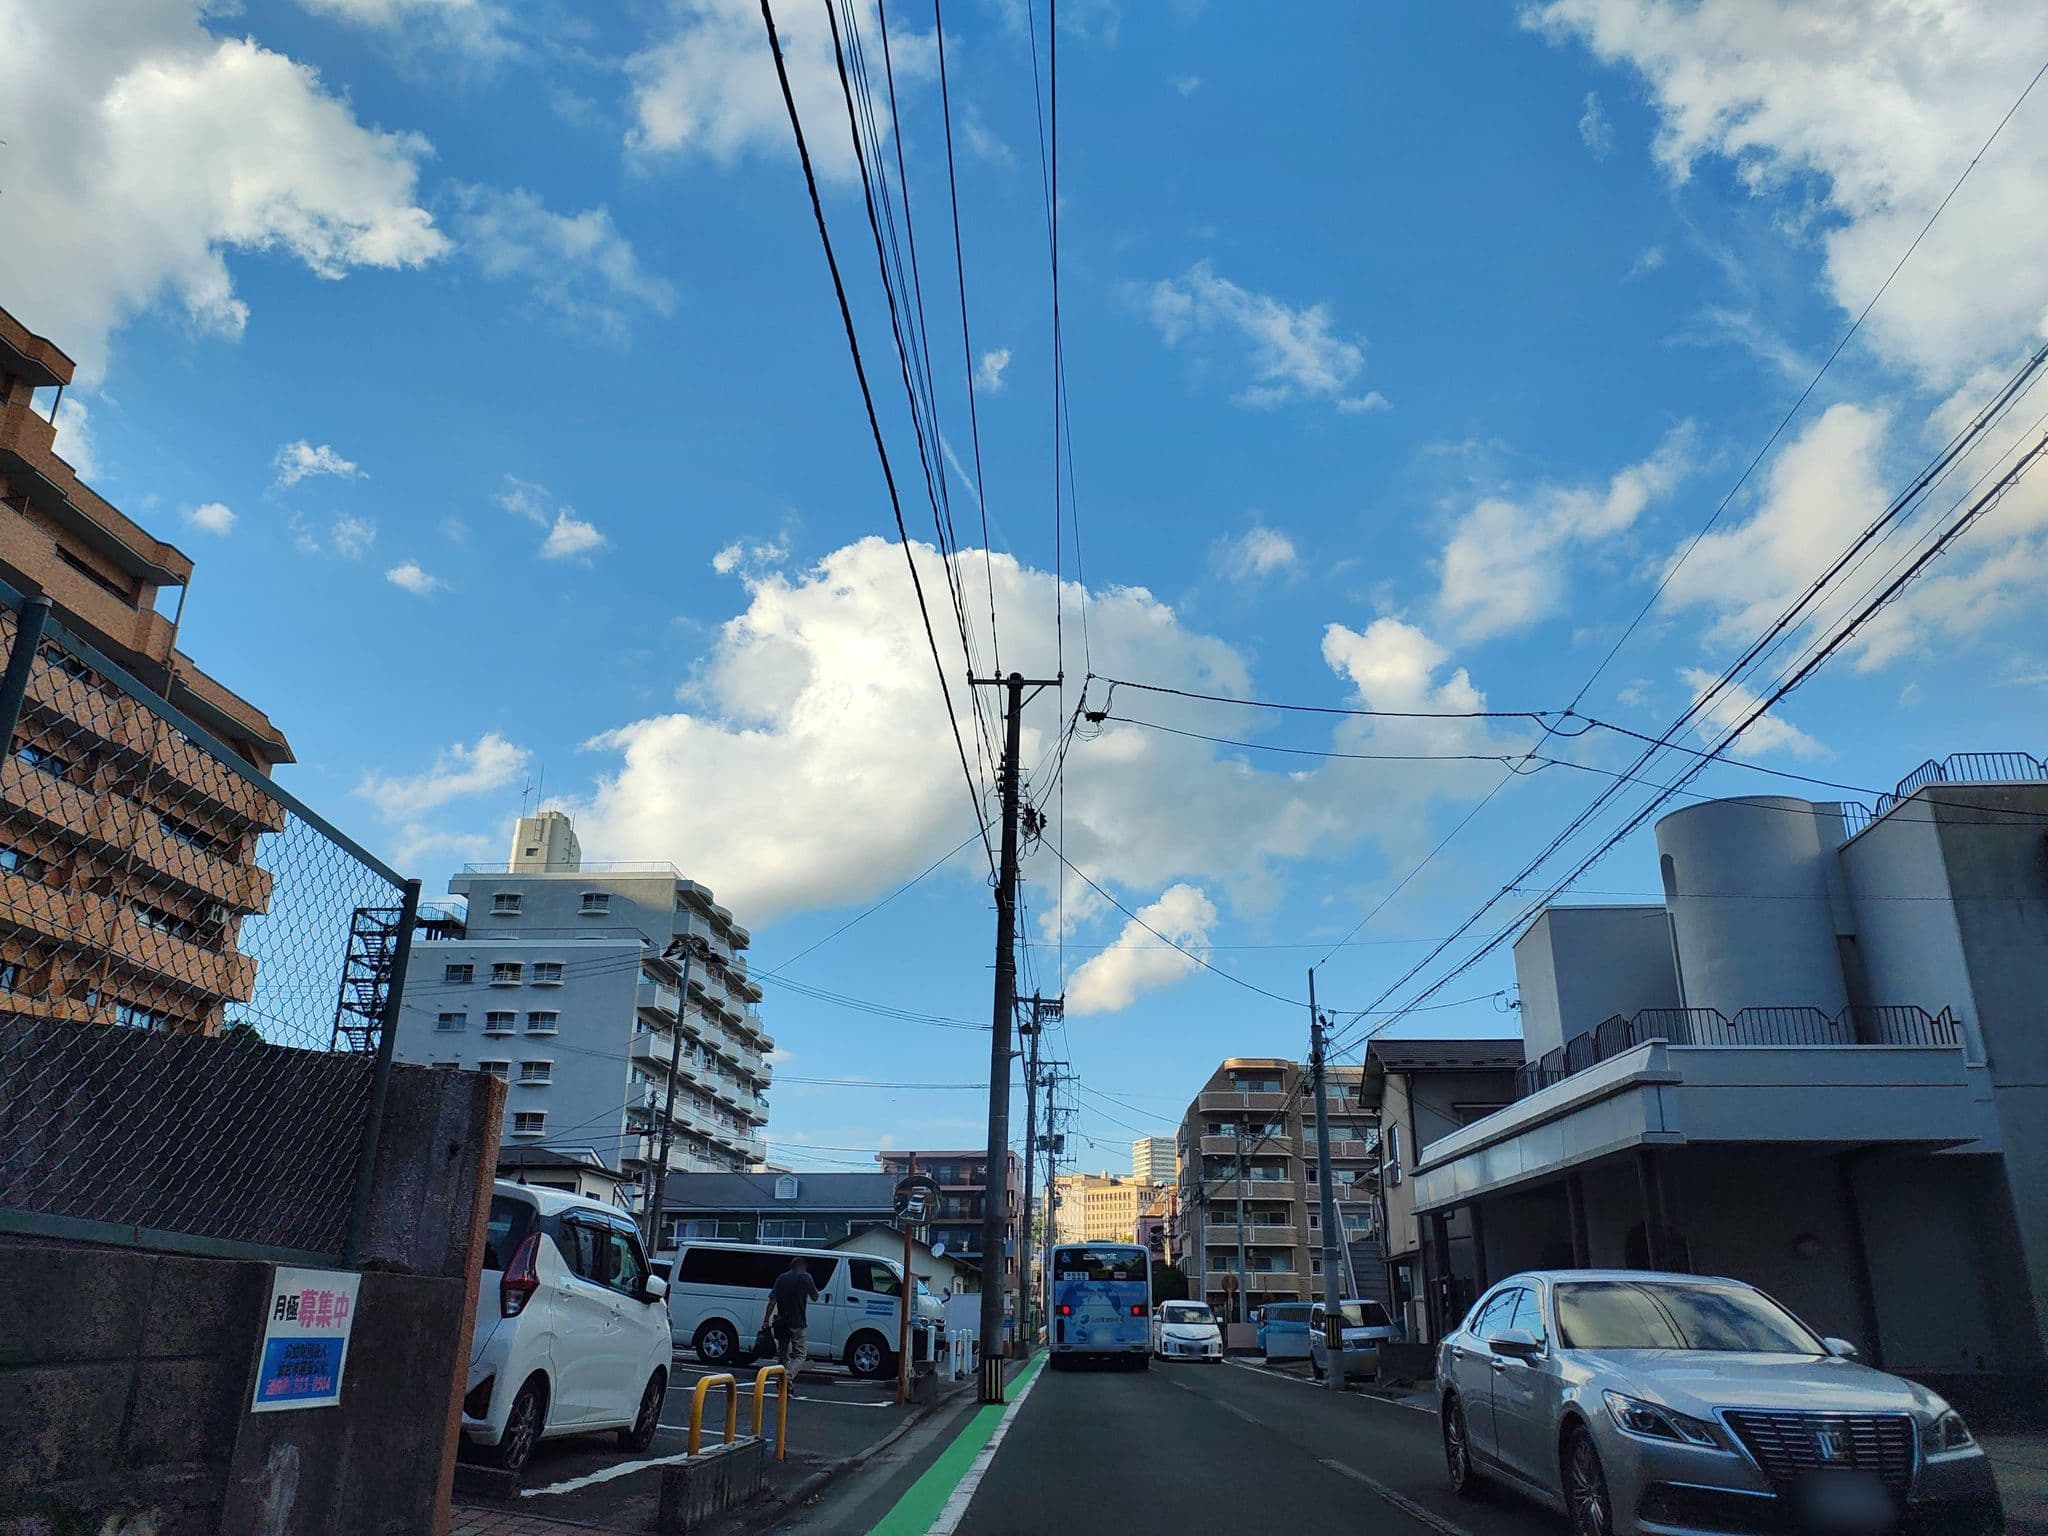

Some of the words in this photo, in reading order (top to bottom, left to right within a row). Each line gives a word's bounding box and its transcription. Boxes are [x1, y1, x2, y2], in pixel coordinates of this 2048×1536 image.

[273, 1289, 350, 1328] 月極募集中
